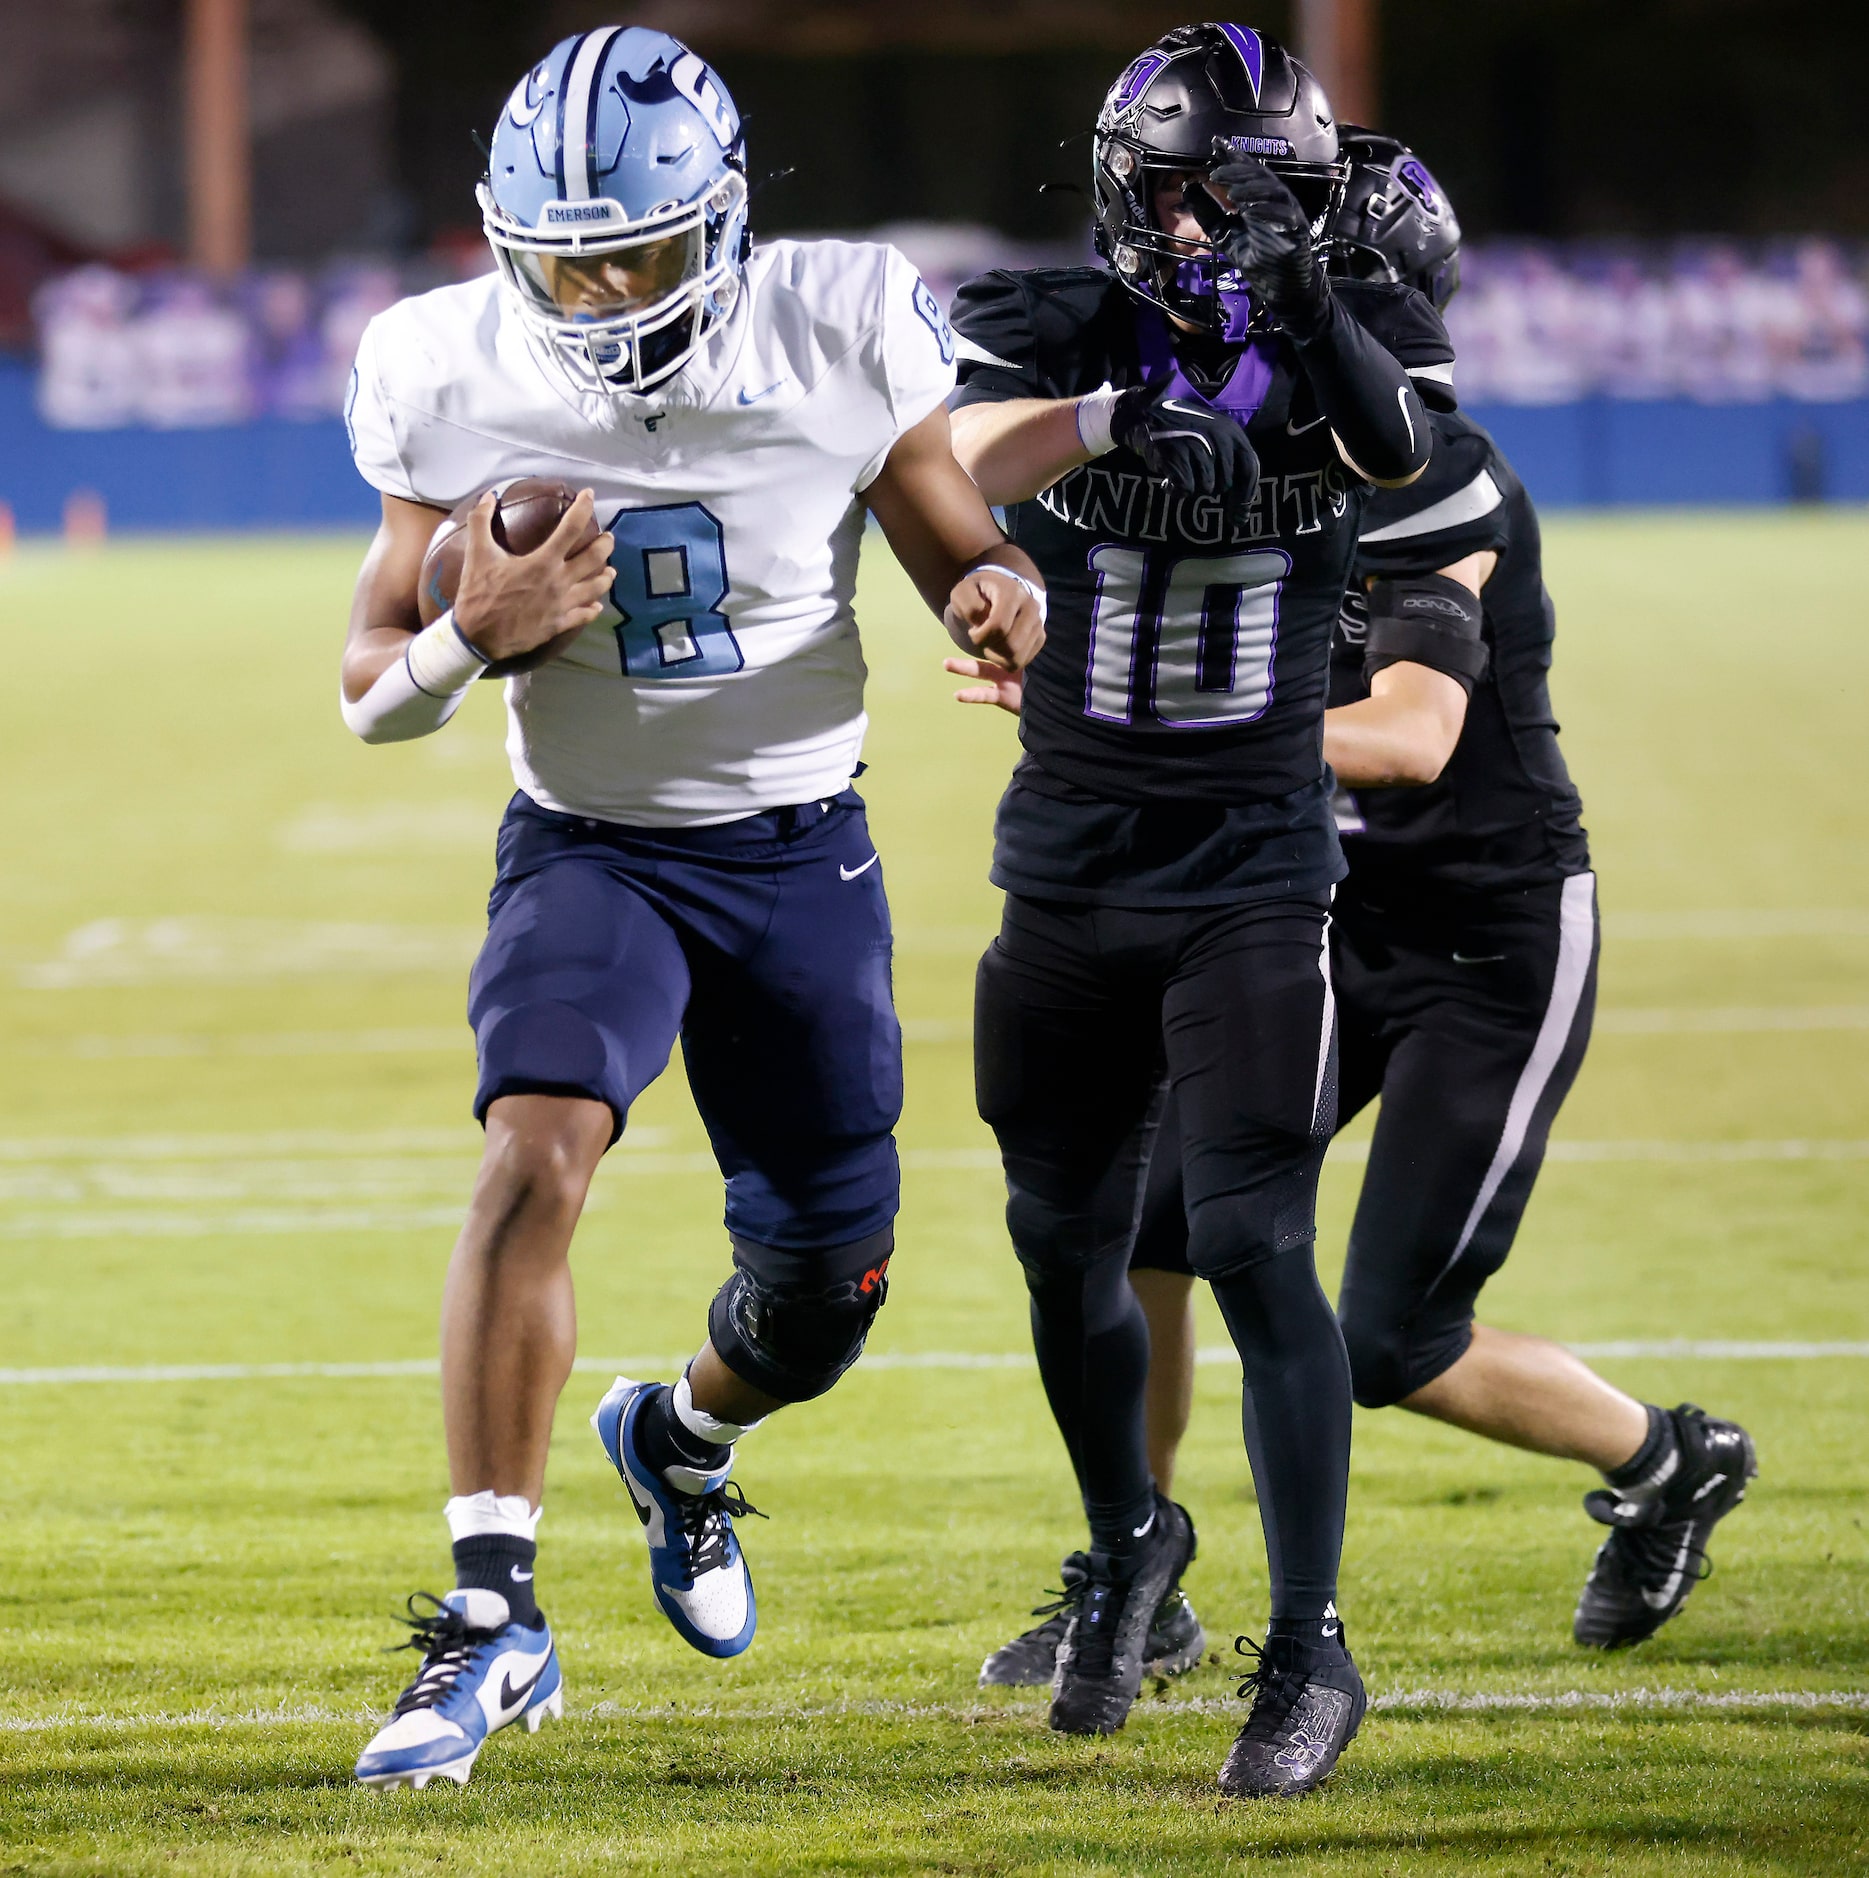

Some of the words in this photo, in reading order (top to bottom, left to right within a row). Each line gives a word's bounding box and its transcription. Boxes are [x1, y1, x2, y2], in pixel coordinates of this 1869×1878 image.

[1230, 135, 1288, 155] KNIGHTS
[547, 205, 611, 223] EMERSON
[911, 275, 955, 366] 8
[606, 501, 746, 677] 8
[1083, 542, 1293, 729] 10
